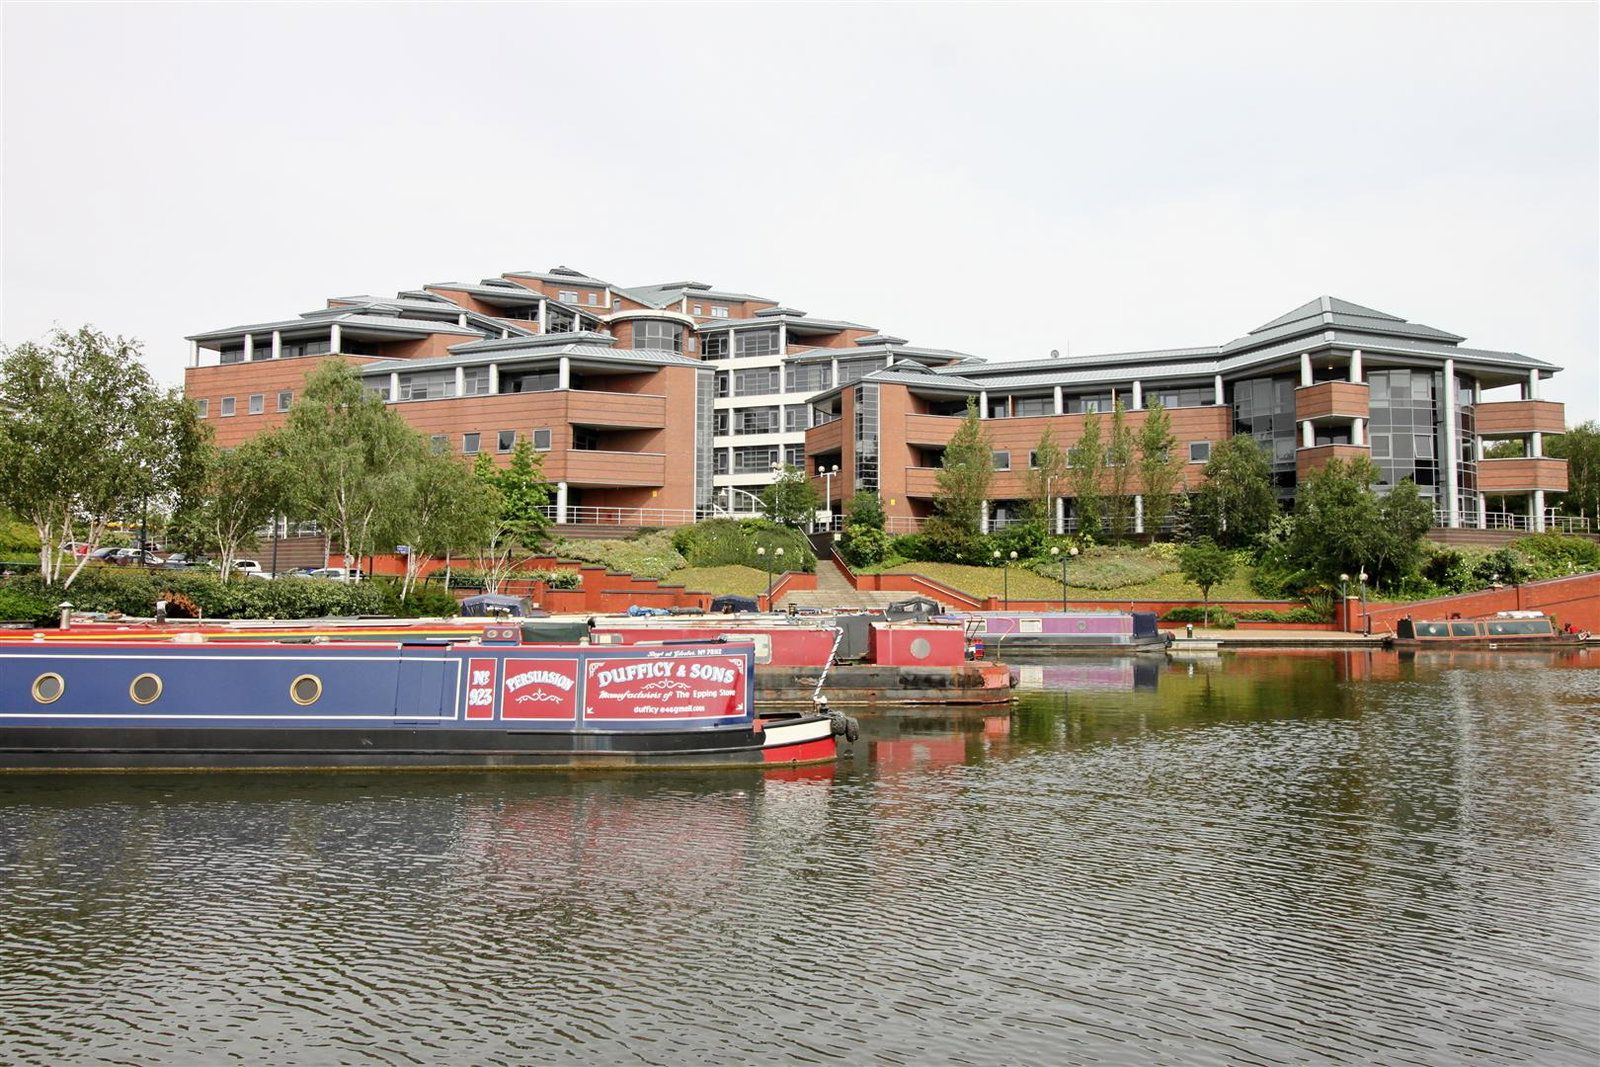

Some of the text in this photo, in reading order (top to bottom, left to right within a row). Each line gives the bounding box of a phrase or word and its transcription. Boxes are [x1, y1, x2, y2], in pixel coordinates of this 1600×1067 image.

[505, 670, 575, 693] PERSUASION
[598, 662, 736, 688] DUFFICY & SONS
[469, 688, 493, 706] 923
[662, 691, 673, 702] of
[676, 691, 690, 699] The
[693, 690, 717, 699] Epping
